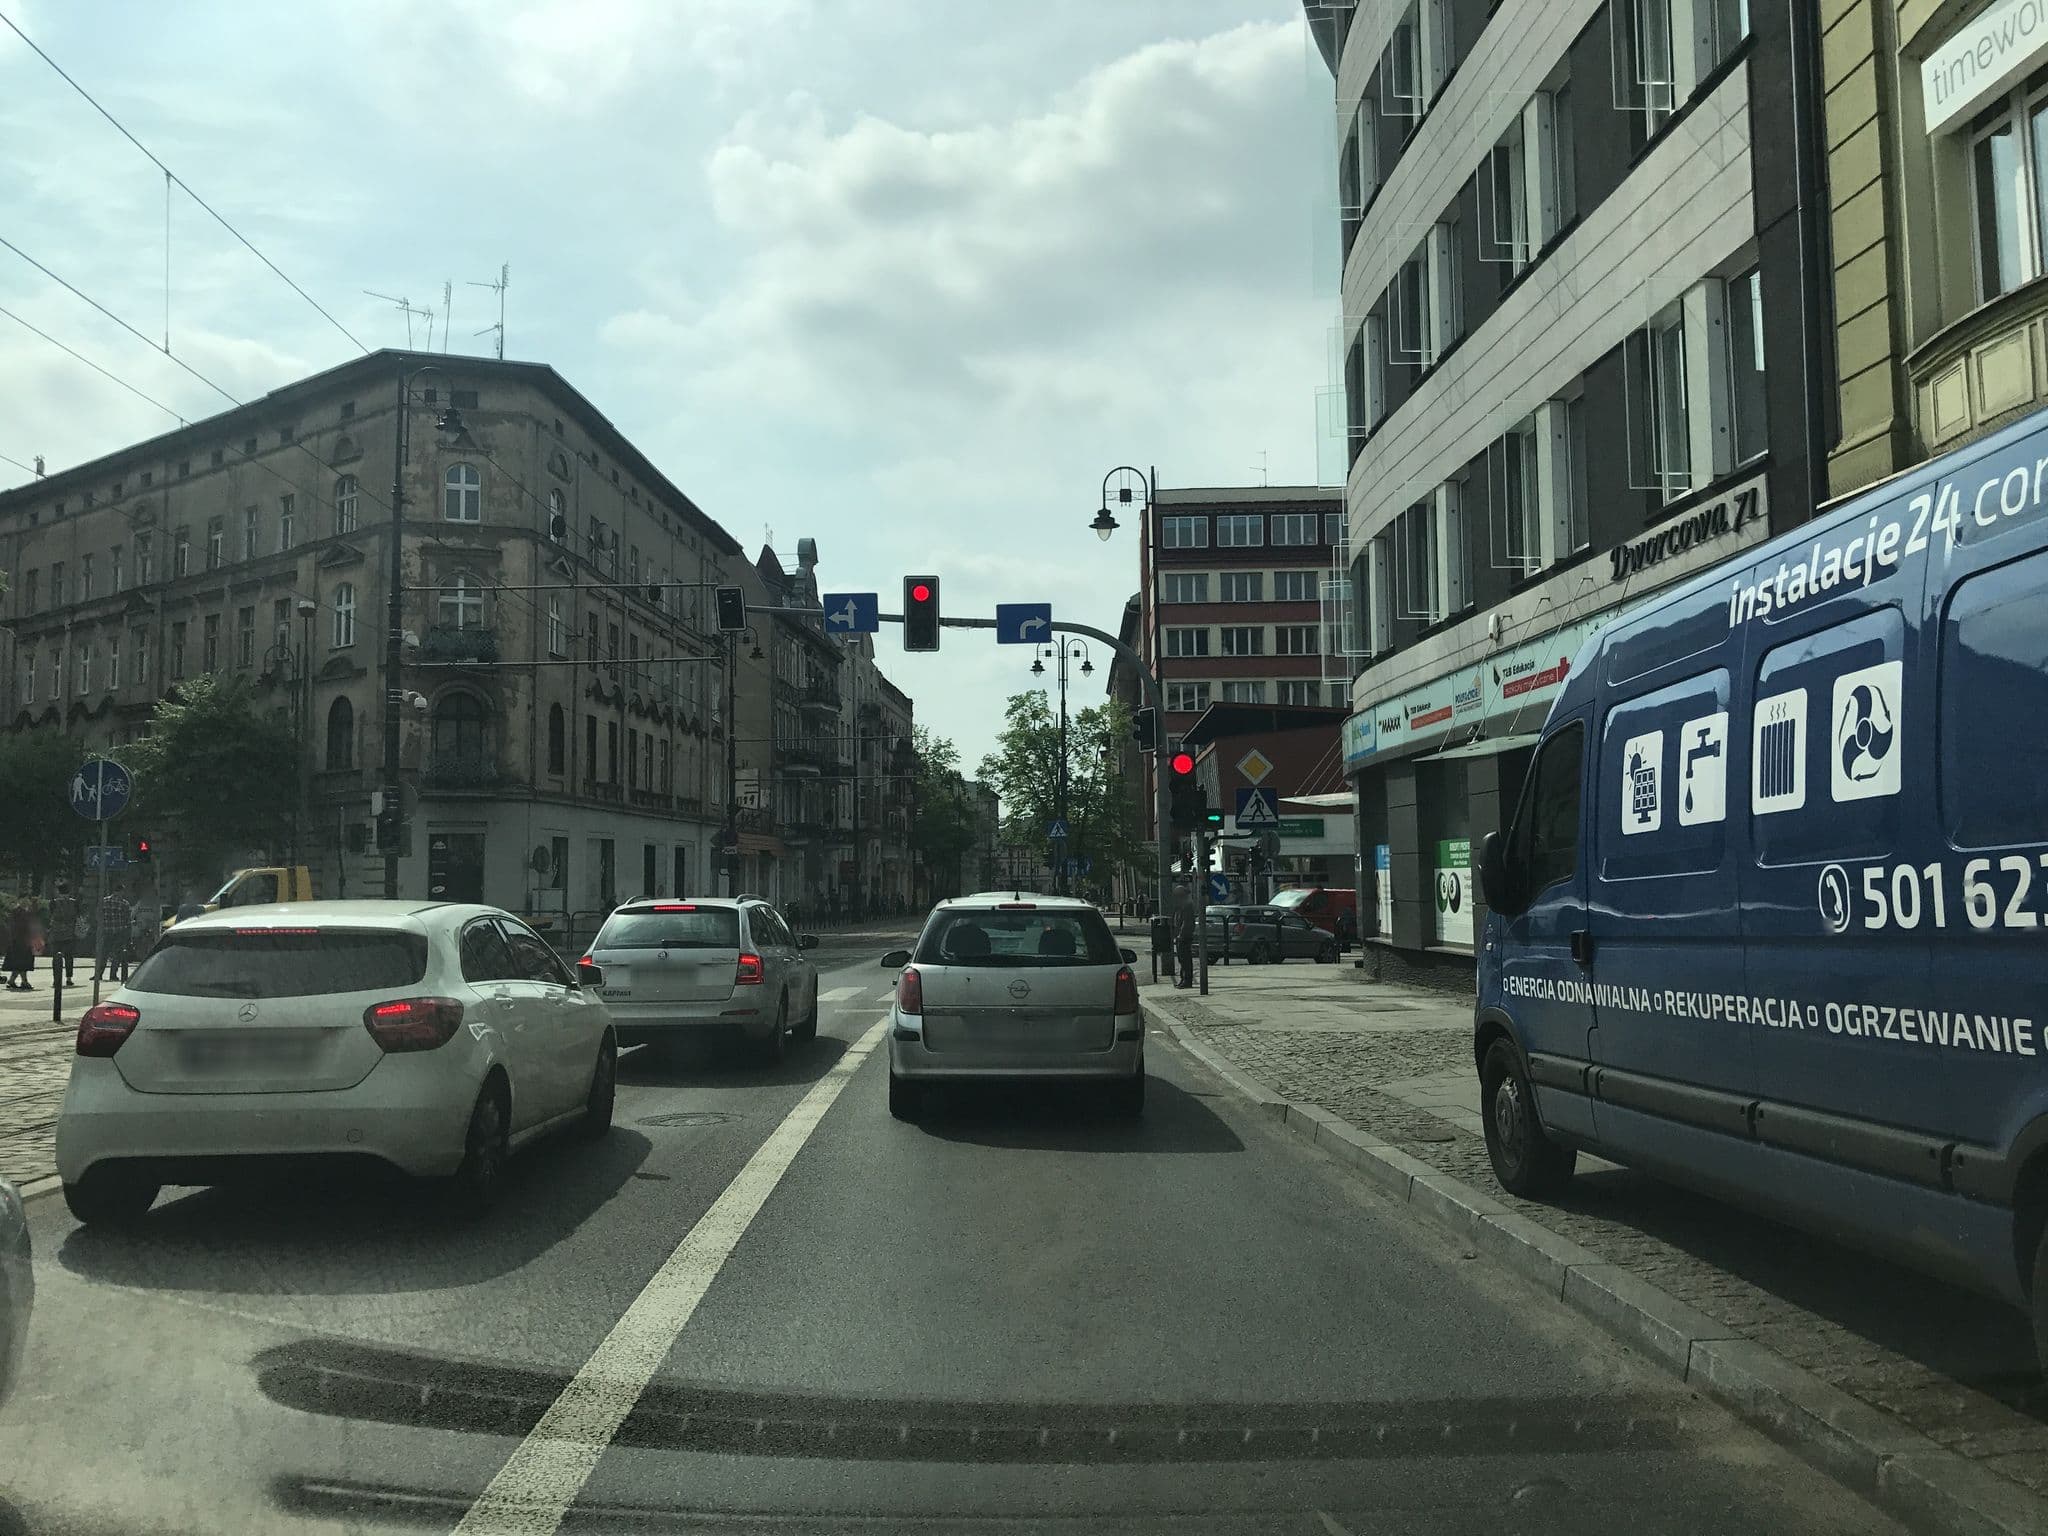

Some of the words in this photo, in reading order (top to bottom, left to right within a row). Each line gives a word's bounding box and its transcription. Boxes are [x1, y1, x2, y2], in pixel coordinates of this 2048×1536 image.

[1610, 503, 1729, 580] Dworcowa
[1733, 487, 1761, 534] 71
[1512, 660, 1535, 675] Edukacja
[1863, 863, 1947, 930] 501
[1509, 976, 1556, 1000] ENERGIA
[1557, 980, 1651, 1013] ODNAWIALNA
[1664, 990, 1804, 1030] REKUPERACJA
[1825, 1001, 2037, 1056] OGRZEWANIE
